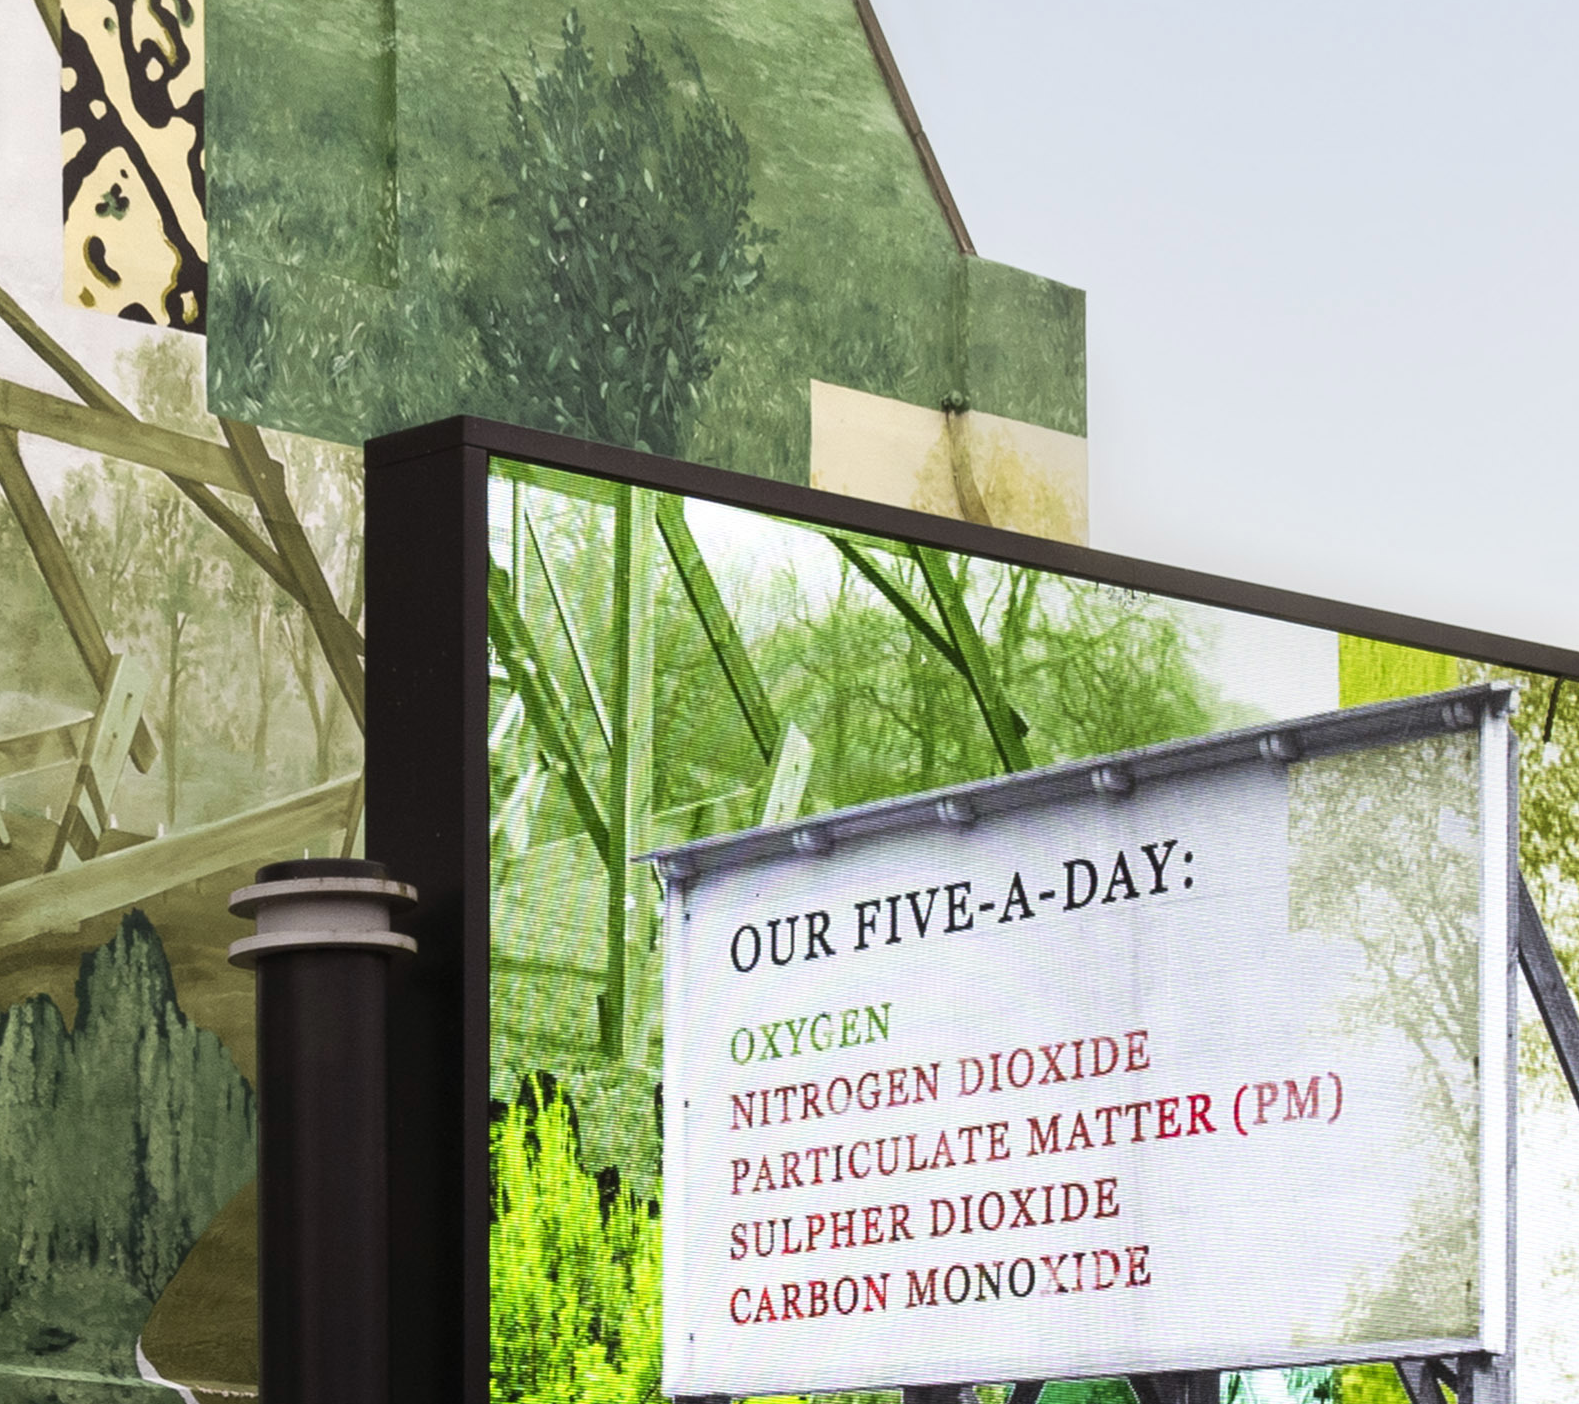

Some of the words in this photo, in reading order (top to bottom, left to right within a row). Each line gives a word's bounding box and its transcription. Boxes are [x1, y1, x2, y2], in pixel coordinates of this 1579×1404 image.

[730, 910, 837, 973] OUR
[854, 840, 1193, 951] FIVE-A-DAY:
[730, 1001, 893, 1065] OXYGEN
[730, 1062, 942, 1130] NITROGEN
[957, 1029, 1151, 1098] DIOXIDE
[730, 1120, 1012, 1196] PARTICULATE
[1026, 1092, 1217, 1157] MATTER
[1234, 1071, 1344, 1138] (PM)
[729, 1203, 915, 1262] SULPHER
[929, 1177, 1121, 1238] DIOXIDE
[729, 1272, 890, 1326] CARBON
[905, 1244, 1152, 1309] MONOXIDE
